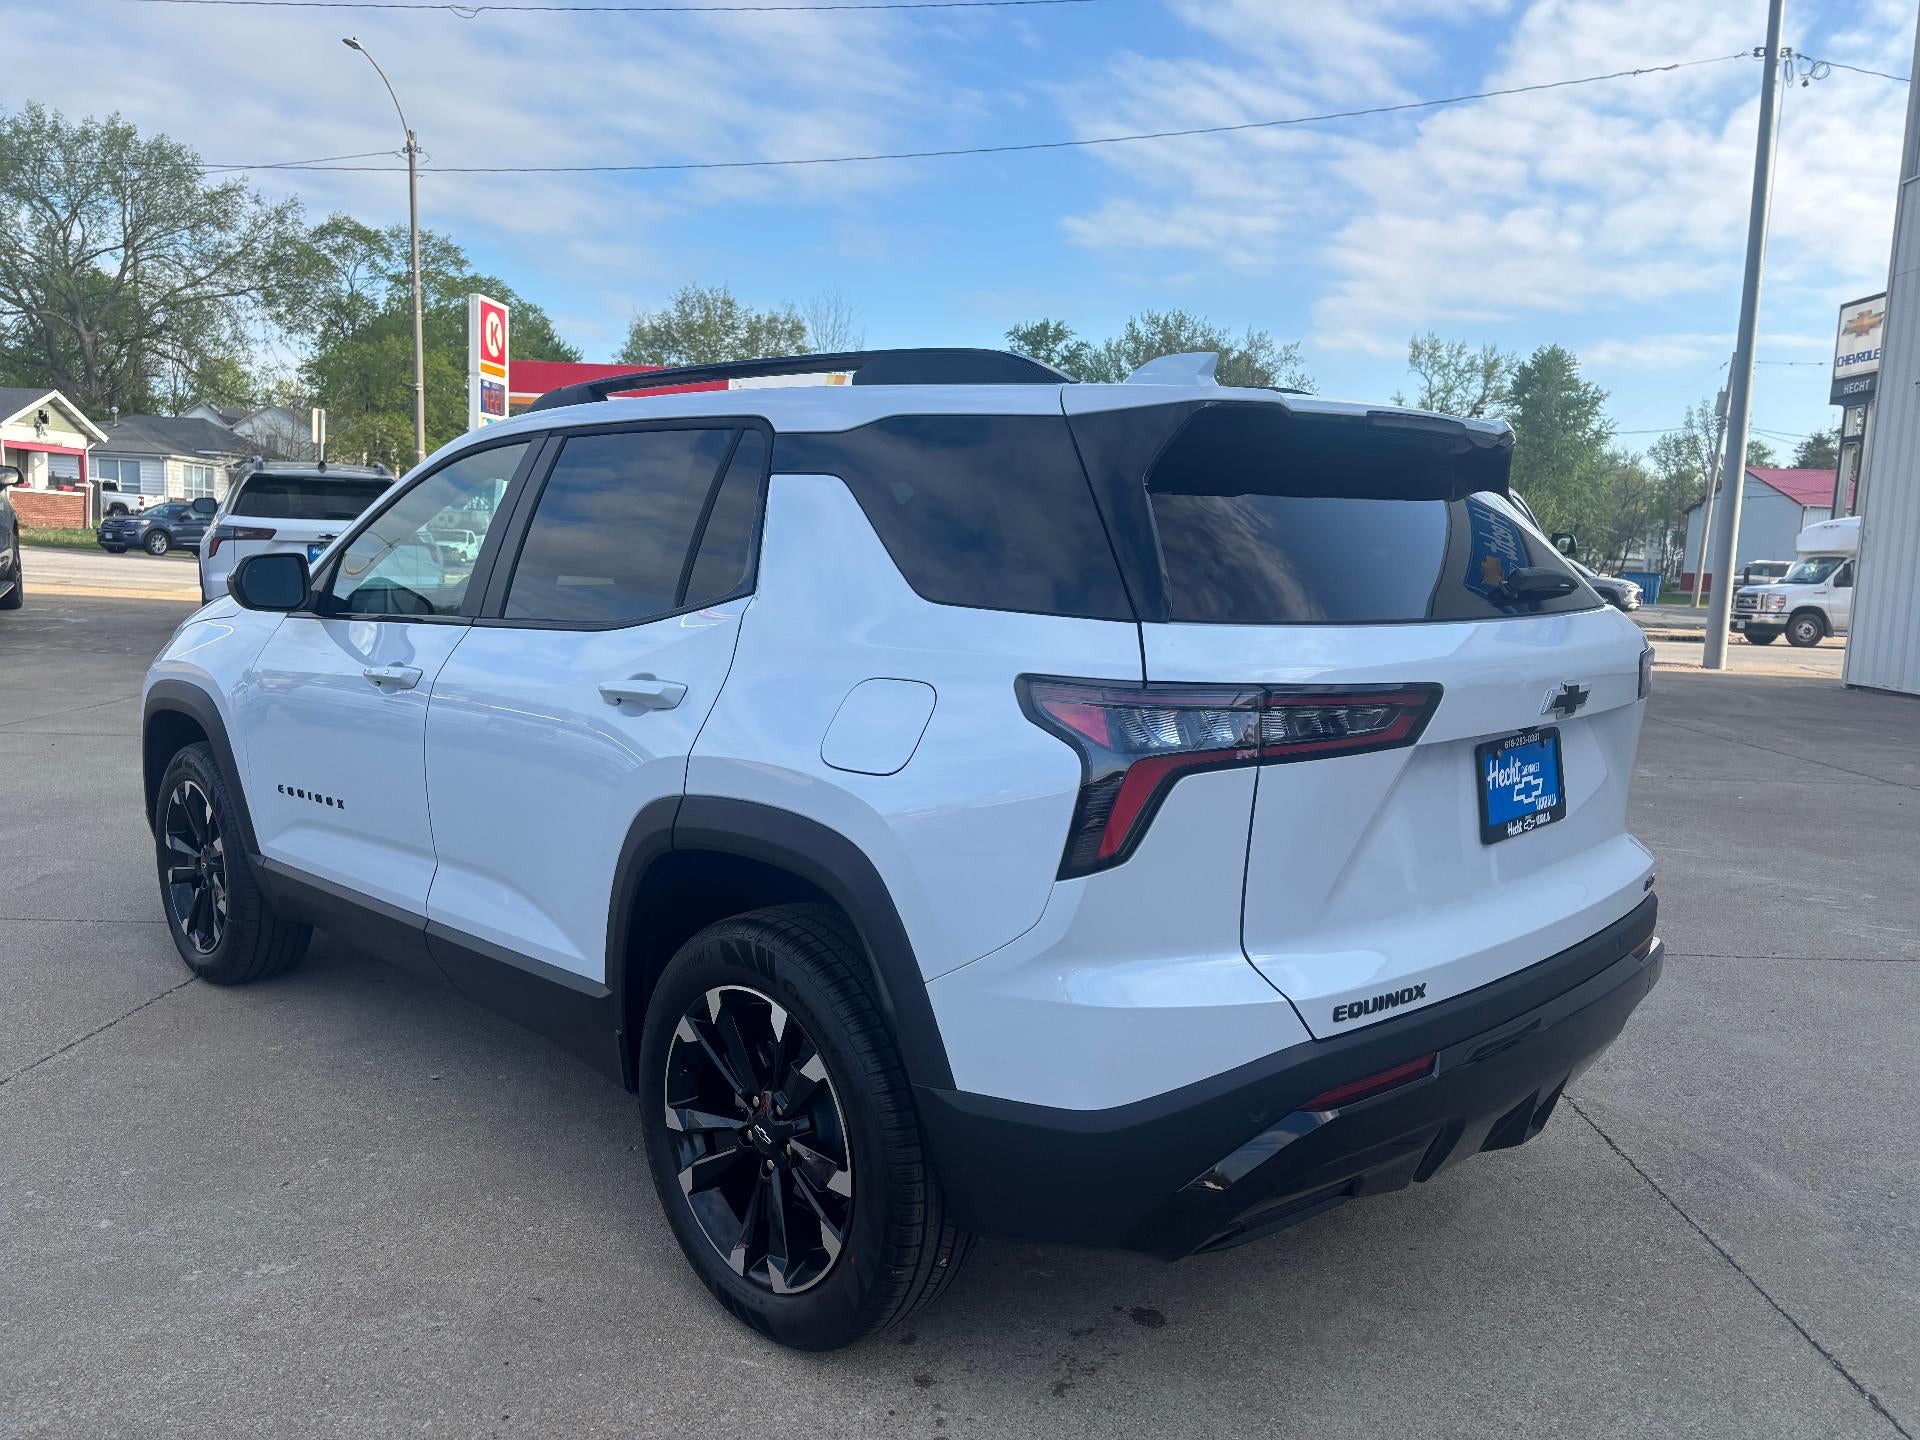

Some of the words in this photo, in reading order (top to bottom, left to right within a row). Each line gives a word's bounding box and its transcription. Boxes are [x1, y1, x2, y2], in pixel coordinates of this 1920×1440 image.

[1836, 348, 1881, 367] CHEVROLE
[1843, 379, 1871, 395] HECHT
[1487, 755, 1521, 791] Hecht
[277, 784, 345, 810] EQUINOX
[1332, 982, 1427, 1023] EQUINOX
